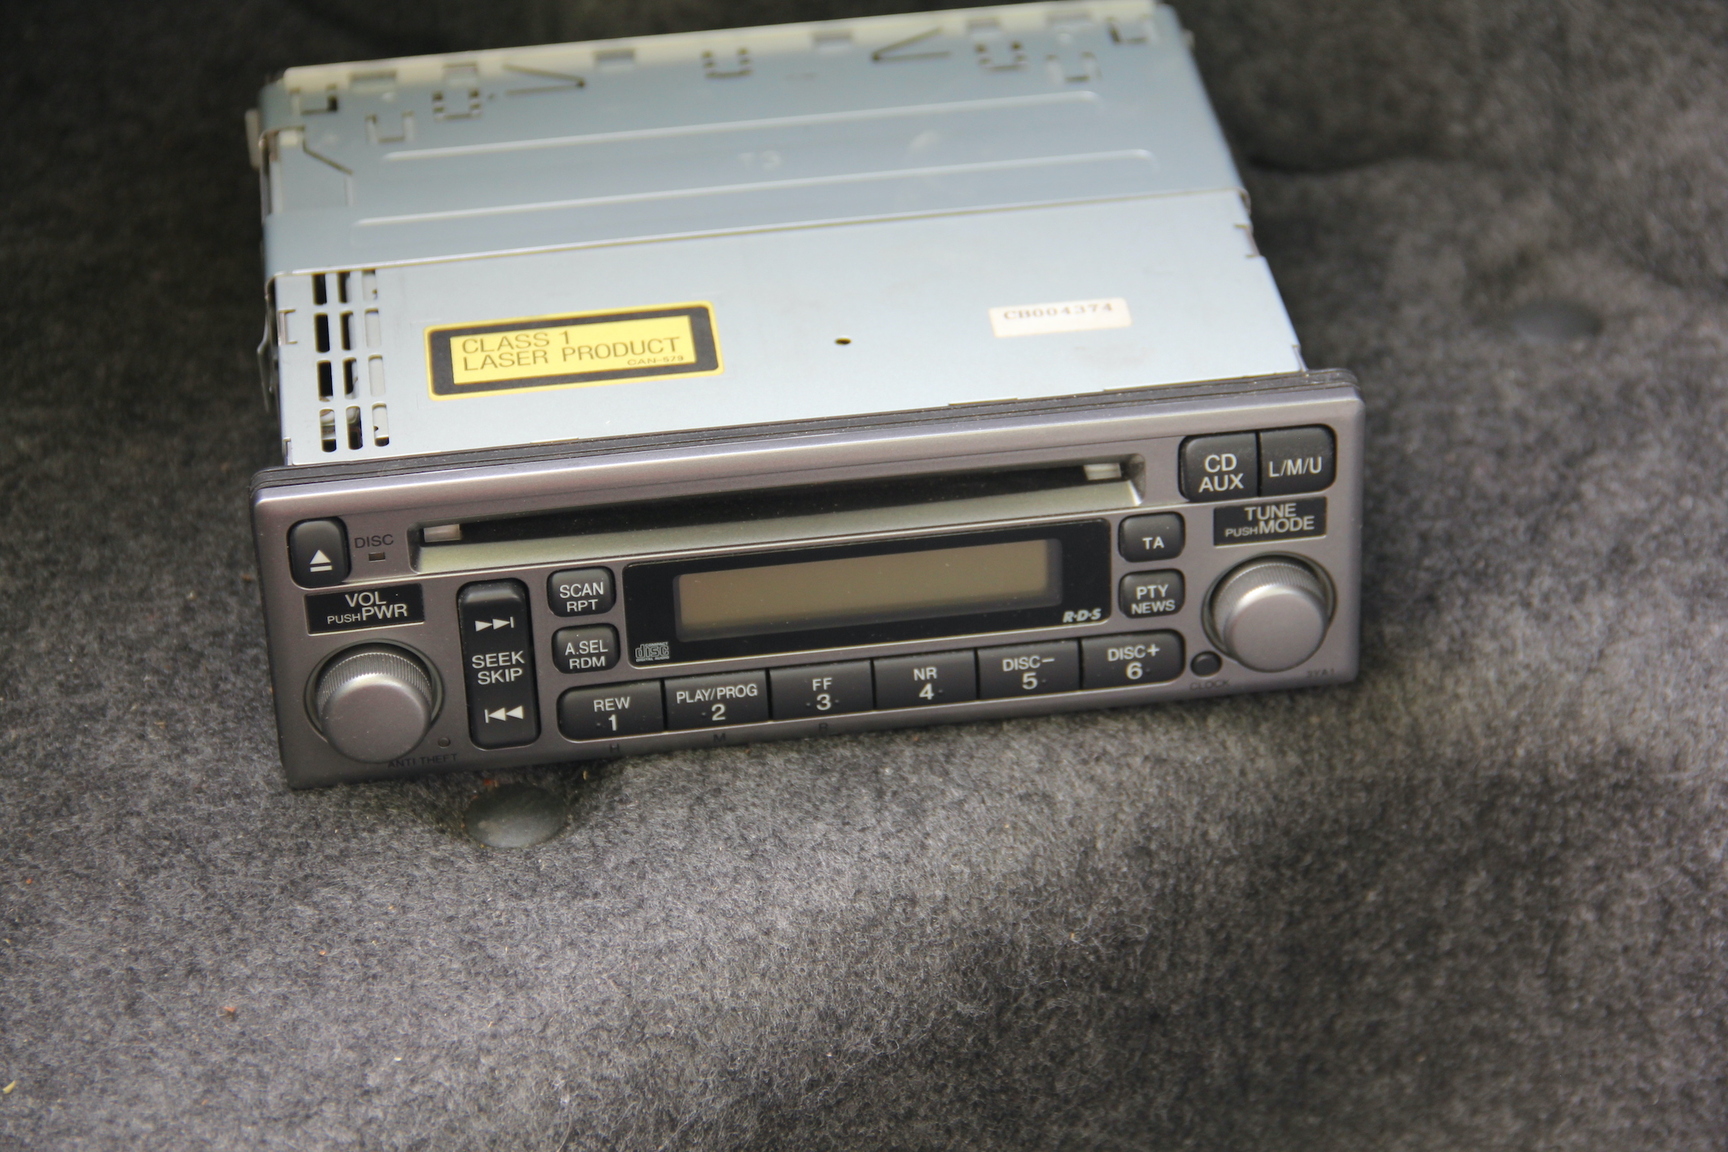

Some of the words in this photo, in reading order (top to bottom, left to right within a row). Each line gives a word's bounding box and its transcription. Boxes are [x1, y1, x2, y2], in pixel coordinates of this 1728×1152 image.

[1004, 303, 1113, 320] CB004374
[462, 332, 550, 355] CLASS
[562, 330, 571, 345] 1
[463, 349, 548, 371] LASER
[562, 337, 680, 363] PRODUCT
[1205, 453, 1237, 473] CD
[1269, 456, 1322, 477] L/M/U
[1199, 473, 1244, 493] AUX
[1245, 503, 1296, 521] TUNE
[354, 534, 394, 548] DISC
[1142, 537, 1164, 550] TA
[559, 582, 604, 598] SCAN
[1136, 585, 1169, 600] PTY
[345, 591, 386, 608] VOL
[566, 599, 598, 612] RPT
[1131, 600, 1175, 615] NEWS
[565, 639, 608, 655] A.SEL
[472, 651, 525, 669] SEEK
[569, 656, 606, 670] RDM
[477, 668, 523, 685] SKIP
[913, 667, 937, 681] NR
[1126, 662, 1143, 679] 6
[812, 677, 832, 691] FF
[1022, 673, 1037, 689] 5
[676, 683, 758, 704] PLAY/PROG
[919, 683, 934, 700] 4
[593, 696, 631, 712] REW
[817, 695, 831, 711] 3
[711, 703, 726, 721] 2
[608, 714, 617, 731] 1
[388, 757, 416, 769] ANTI
[420, 753, 457, 765] THEFT
